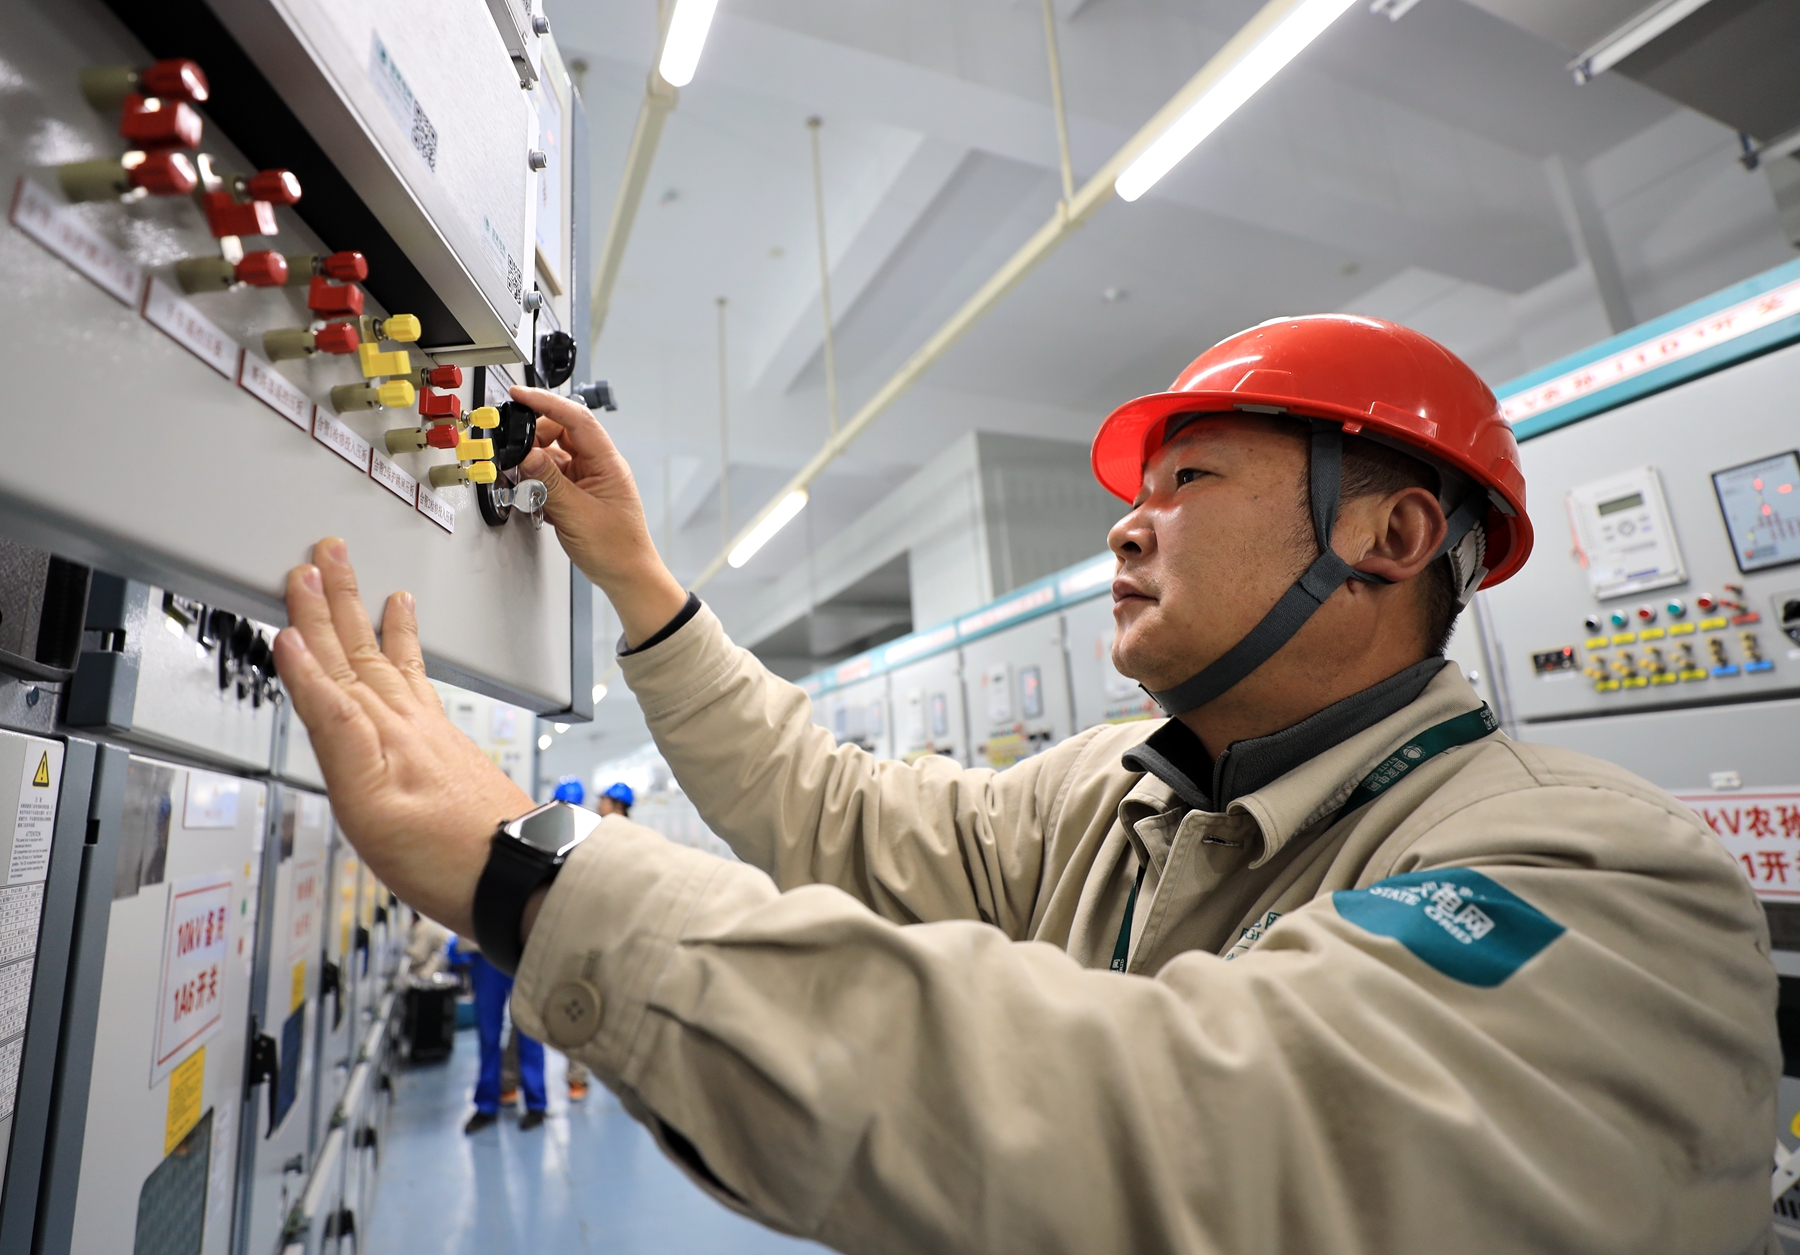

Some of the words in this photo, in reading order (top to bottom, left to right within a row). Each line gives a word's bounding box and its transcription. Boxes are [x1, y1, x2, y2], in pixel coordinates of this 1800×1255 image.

[1366, 759, 1409, 792] 国家电网
[1369, 886, 1421, 906] STATE
